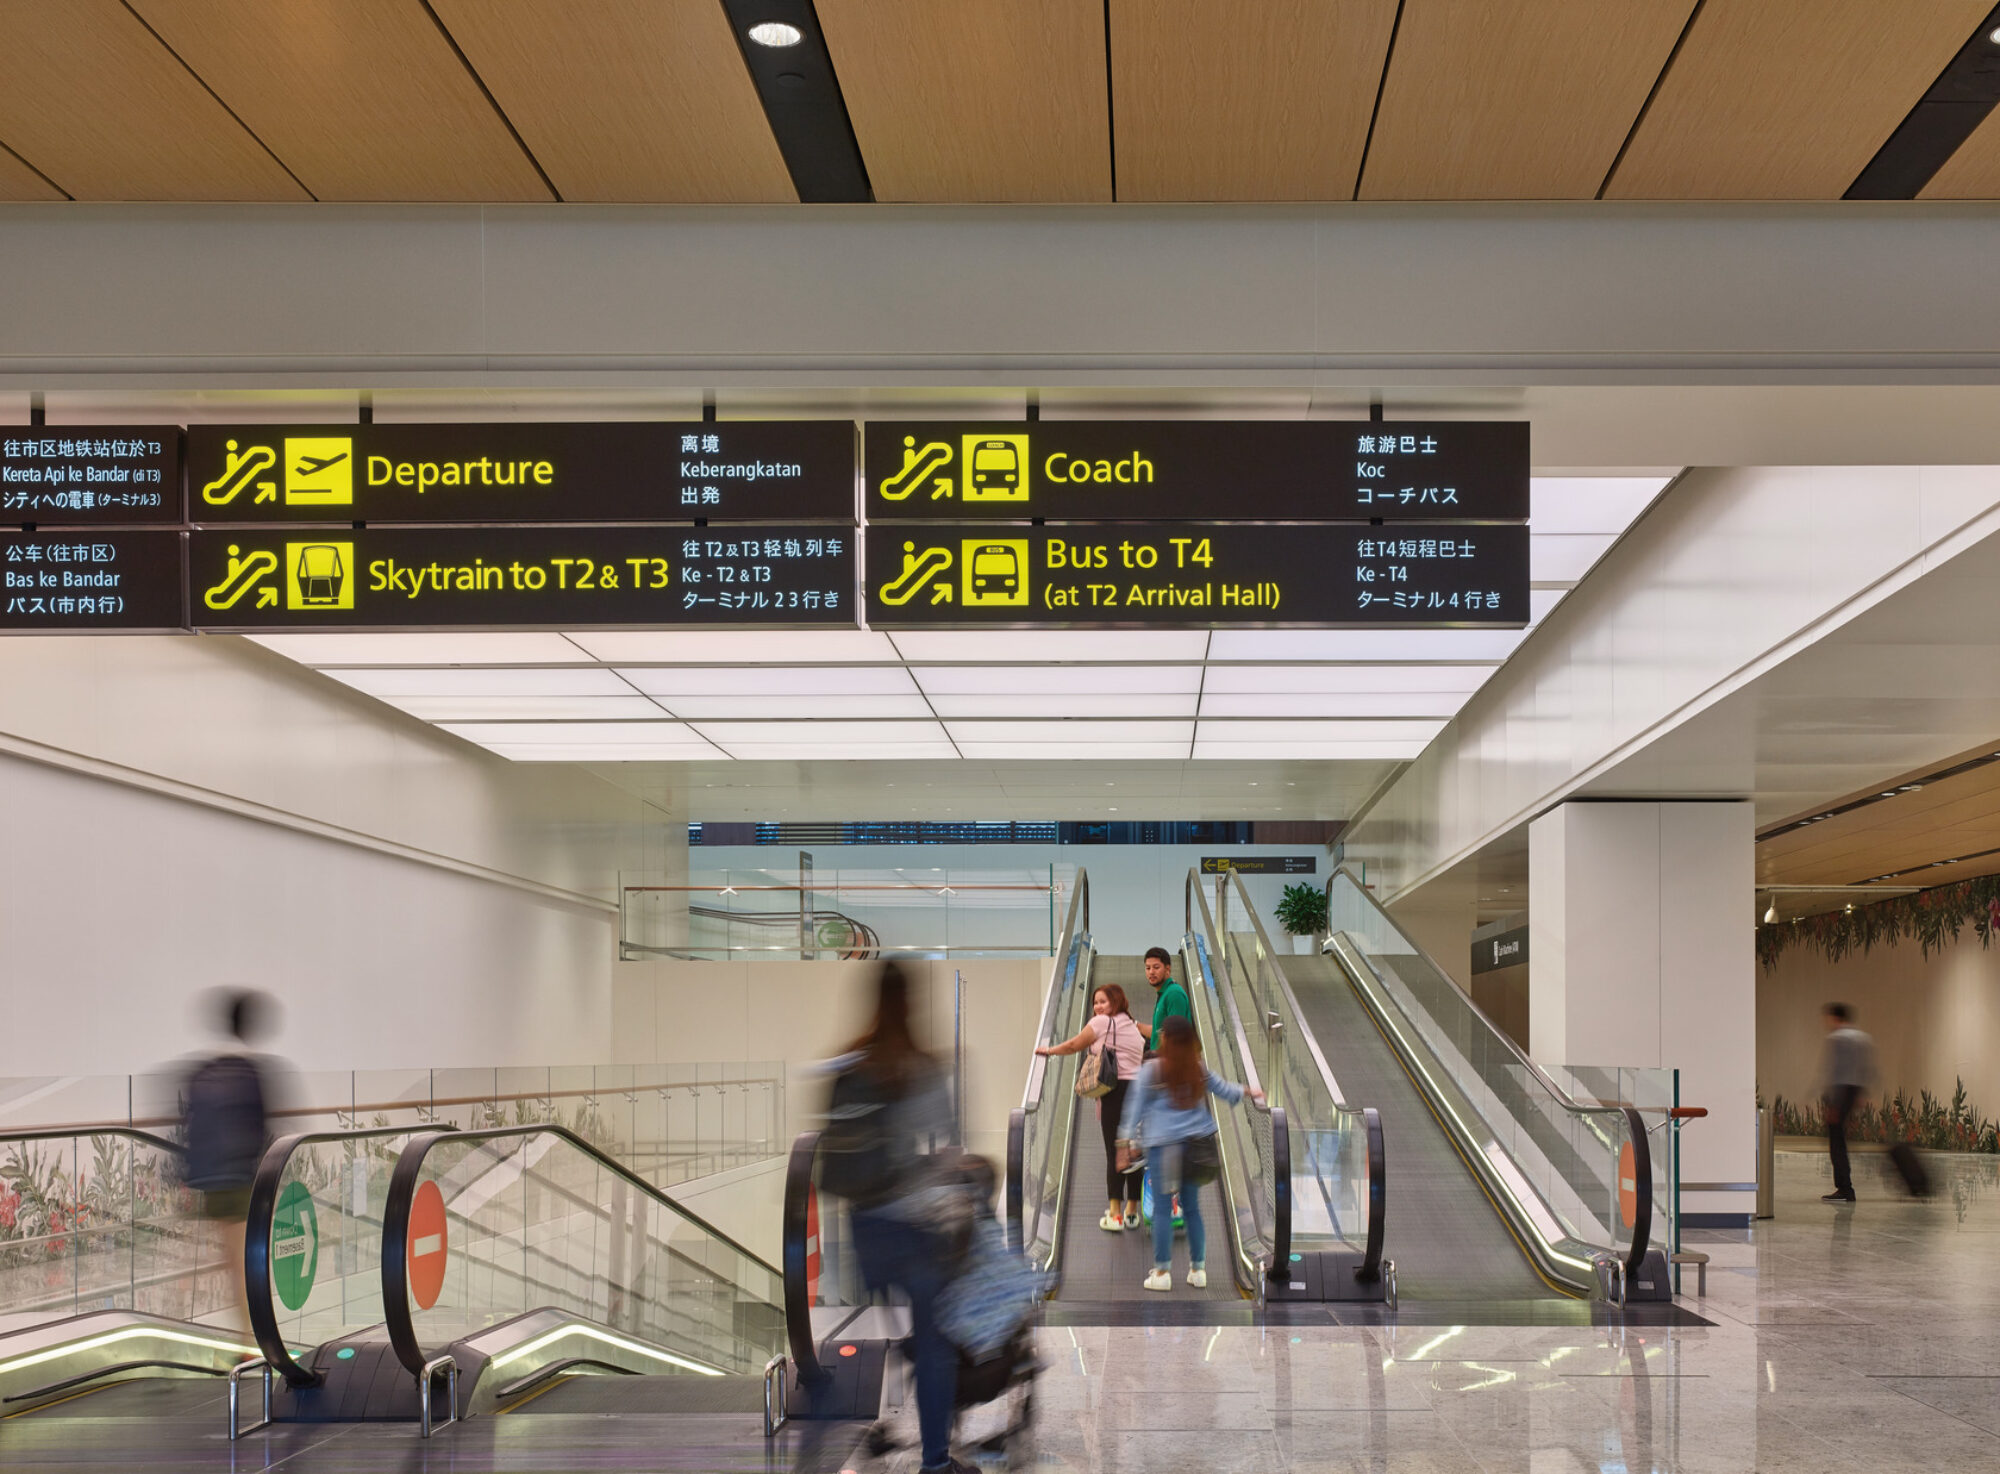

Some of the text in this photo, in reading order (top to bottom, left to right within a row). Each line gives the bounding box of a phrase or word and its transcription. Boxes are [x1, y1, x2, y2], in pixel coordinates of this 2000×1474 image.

[681, 434, 719, 453] 离境
[1358, 435, 1437, 454] 旅游巴士
[3, 465, 160, 486] Kereta Api ke Bandar (di T3)
[368, 456, 554, 493] Departure
[681, 460, 800, 481] Keberangkatan
[1045, 451, 1153, 483] Coach
[1357, 462, 1385, 477] Koc
[682, 486, 720, 504] 出発
[1358, 488, 1458, 504] コーチバス
[1047, 539, 1213, 568] Bus to T4
[6, 570, 120, 587] Bas ke Bandar
[369, 558, 668, 598] Skytrain to T2 & T3
[682, 567, 701, 582] Ke
[716, 567, 734, 582] T2
[740, 569, 749, 582] &
[753, 566, 771, 582] T3
[1357, 566, 1375, 581] Ke
[1389, 566, 1407, 581] T4
[1045, 583, 1280, 609] (at T2 Arrival Hall)
